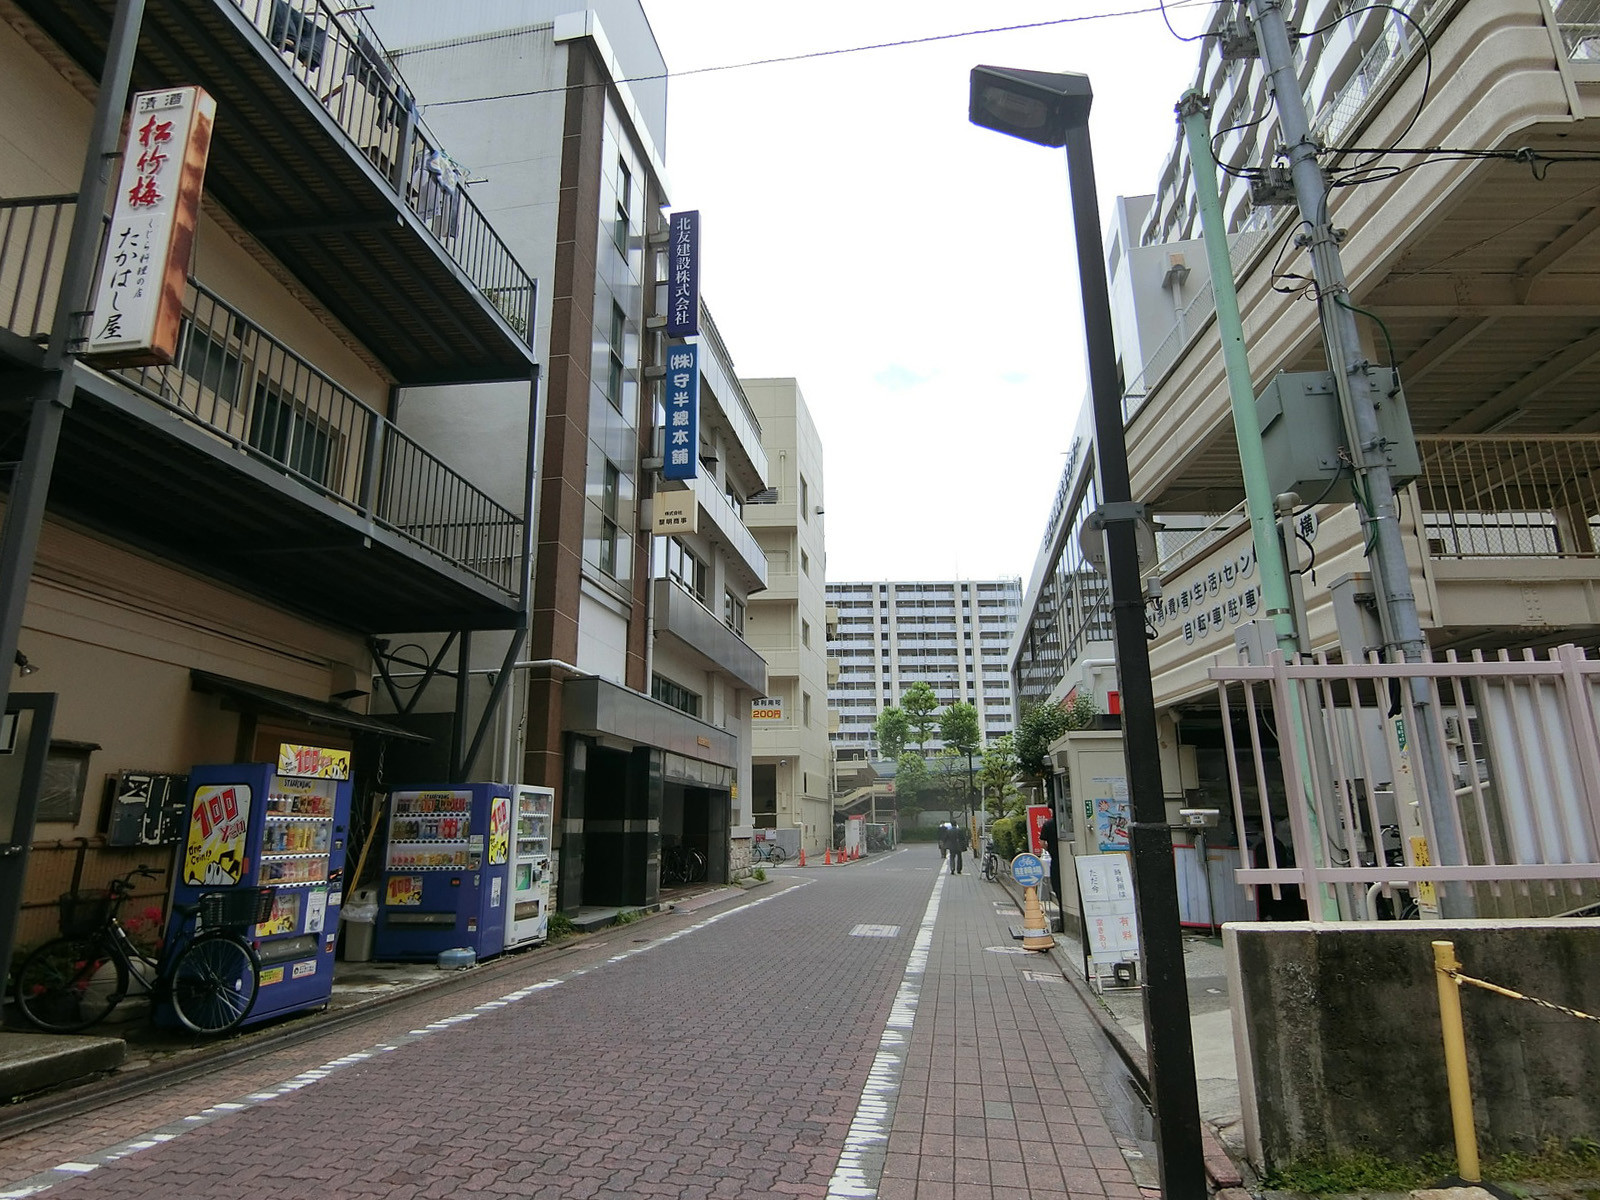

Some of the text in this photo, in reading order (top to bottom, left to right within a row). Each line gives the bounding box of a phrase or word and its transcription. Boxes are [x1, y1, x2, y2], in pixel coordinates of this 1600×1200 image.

[140, 92, 182, 110] 清酒
[129, 114, 173, 207] 松竹梅
[95, 227, 140, 340] たかはし屋
[674, 216, 692, 326] 北友建設株式会社
[294, 749, 319, 775] 100
[193, 788, 238, 840] 100
[220, 819, 247, 843] Yen
[1089, 868, 1100, 894] ただ今
[1118, 916, 1133, 941] 有料
